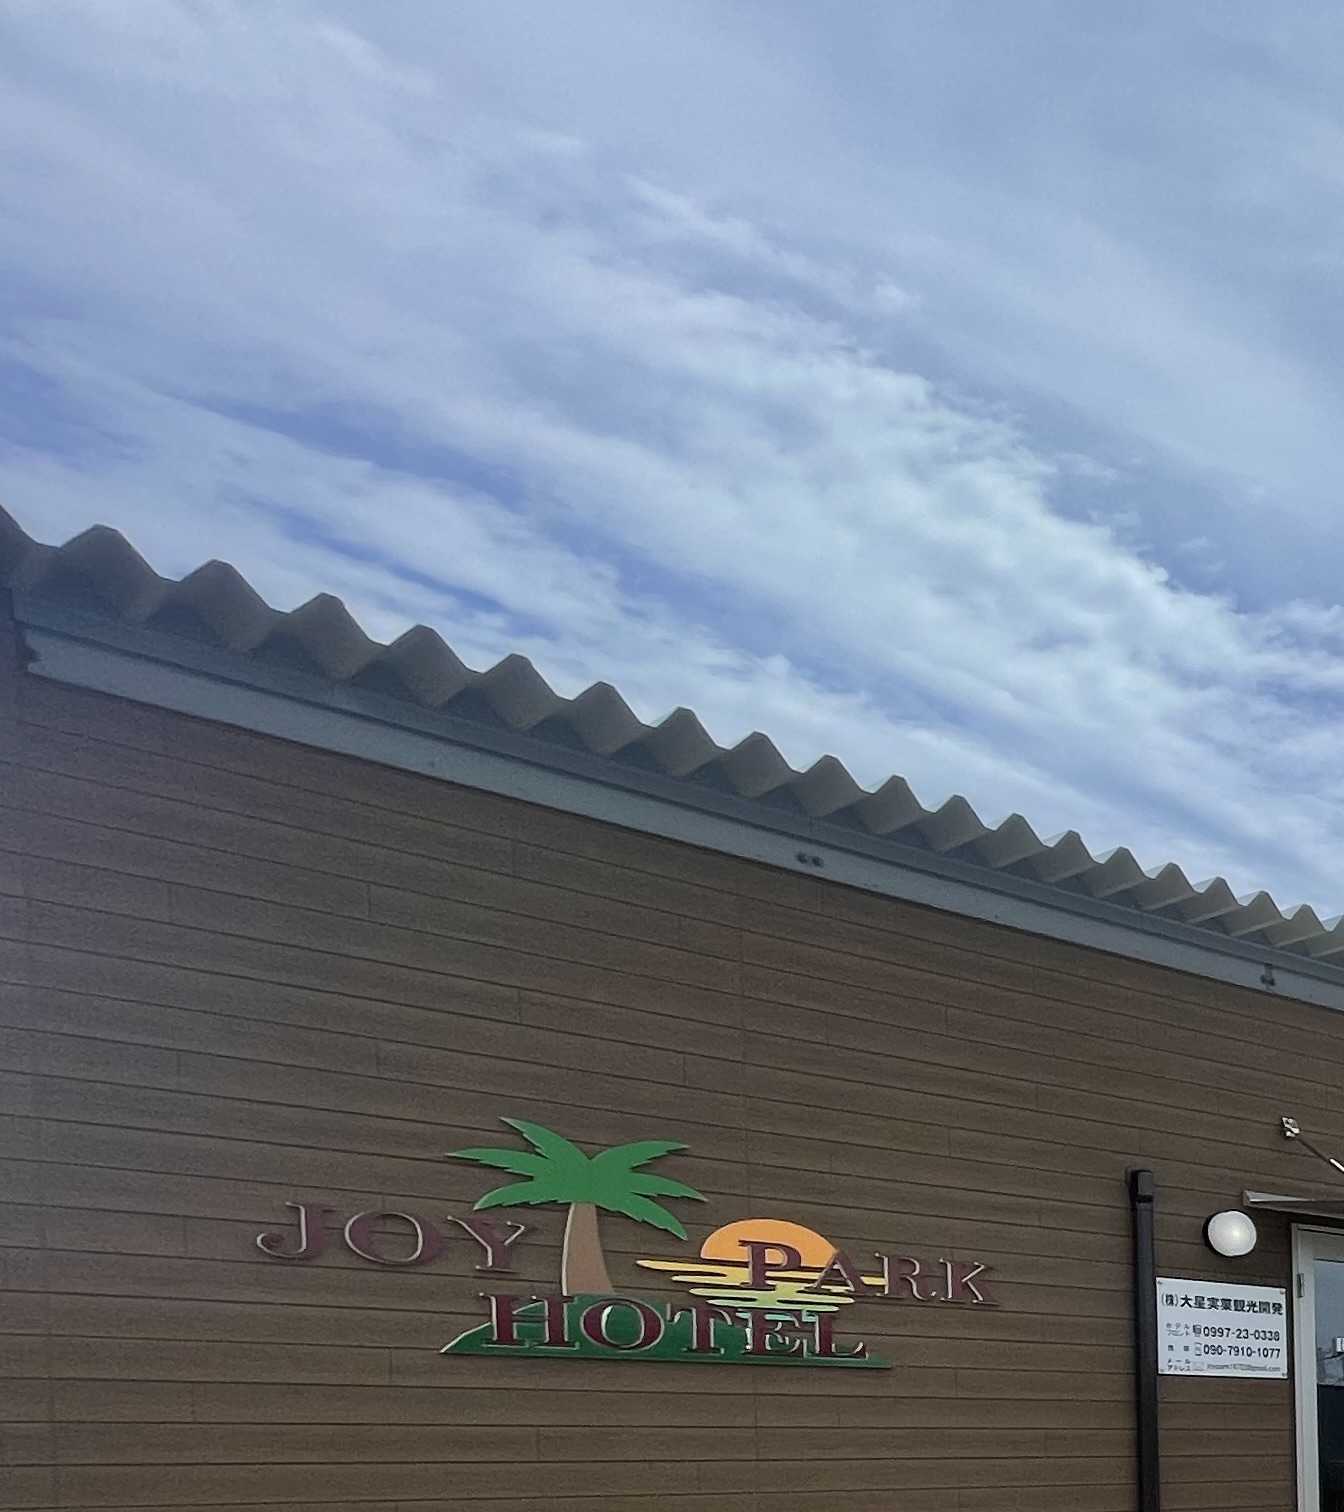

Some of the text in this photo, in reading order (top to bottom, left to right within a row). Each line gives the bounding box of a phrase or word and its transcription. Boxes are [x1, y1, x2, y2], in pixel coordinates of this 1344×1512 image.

[256, 1201, 998, 1306] JOY PARK
[479, 1292, 868, 1359] HOTEL
[1202, 1344, 1281, 1359] 090-7910-1077
